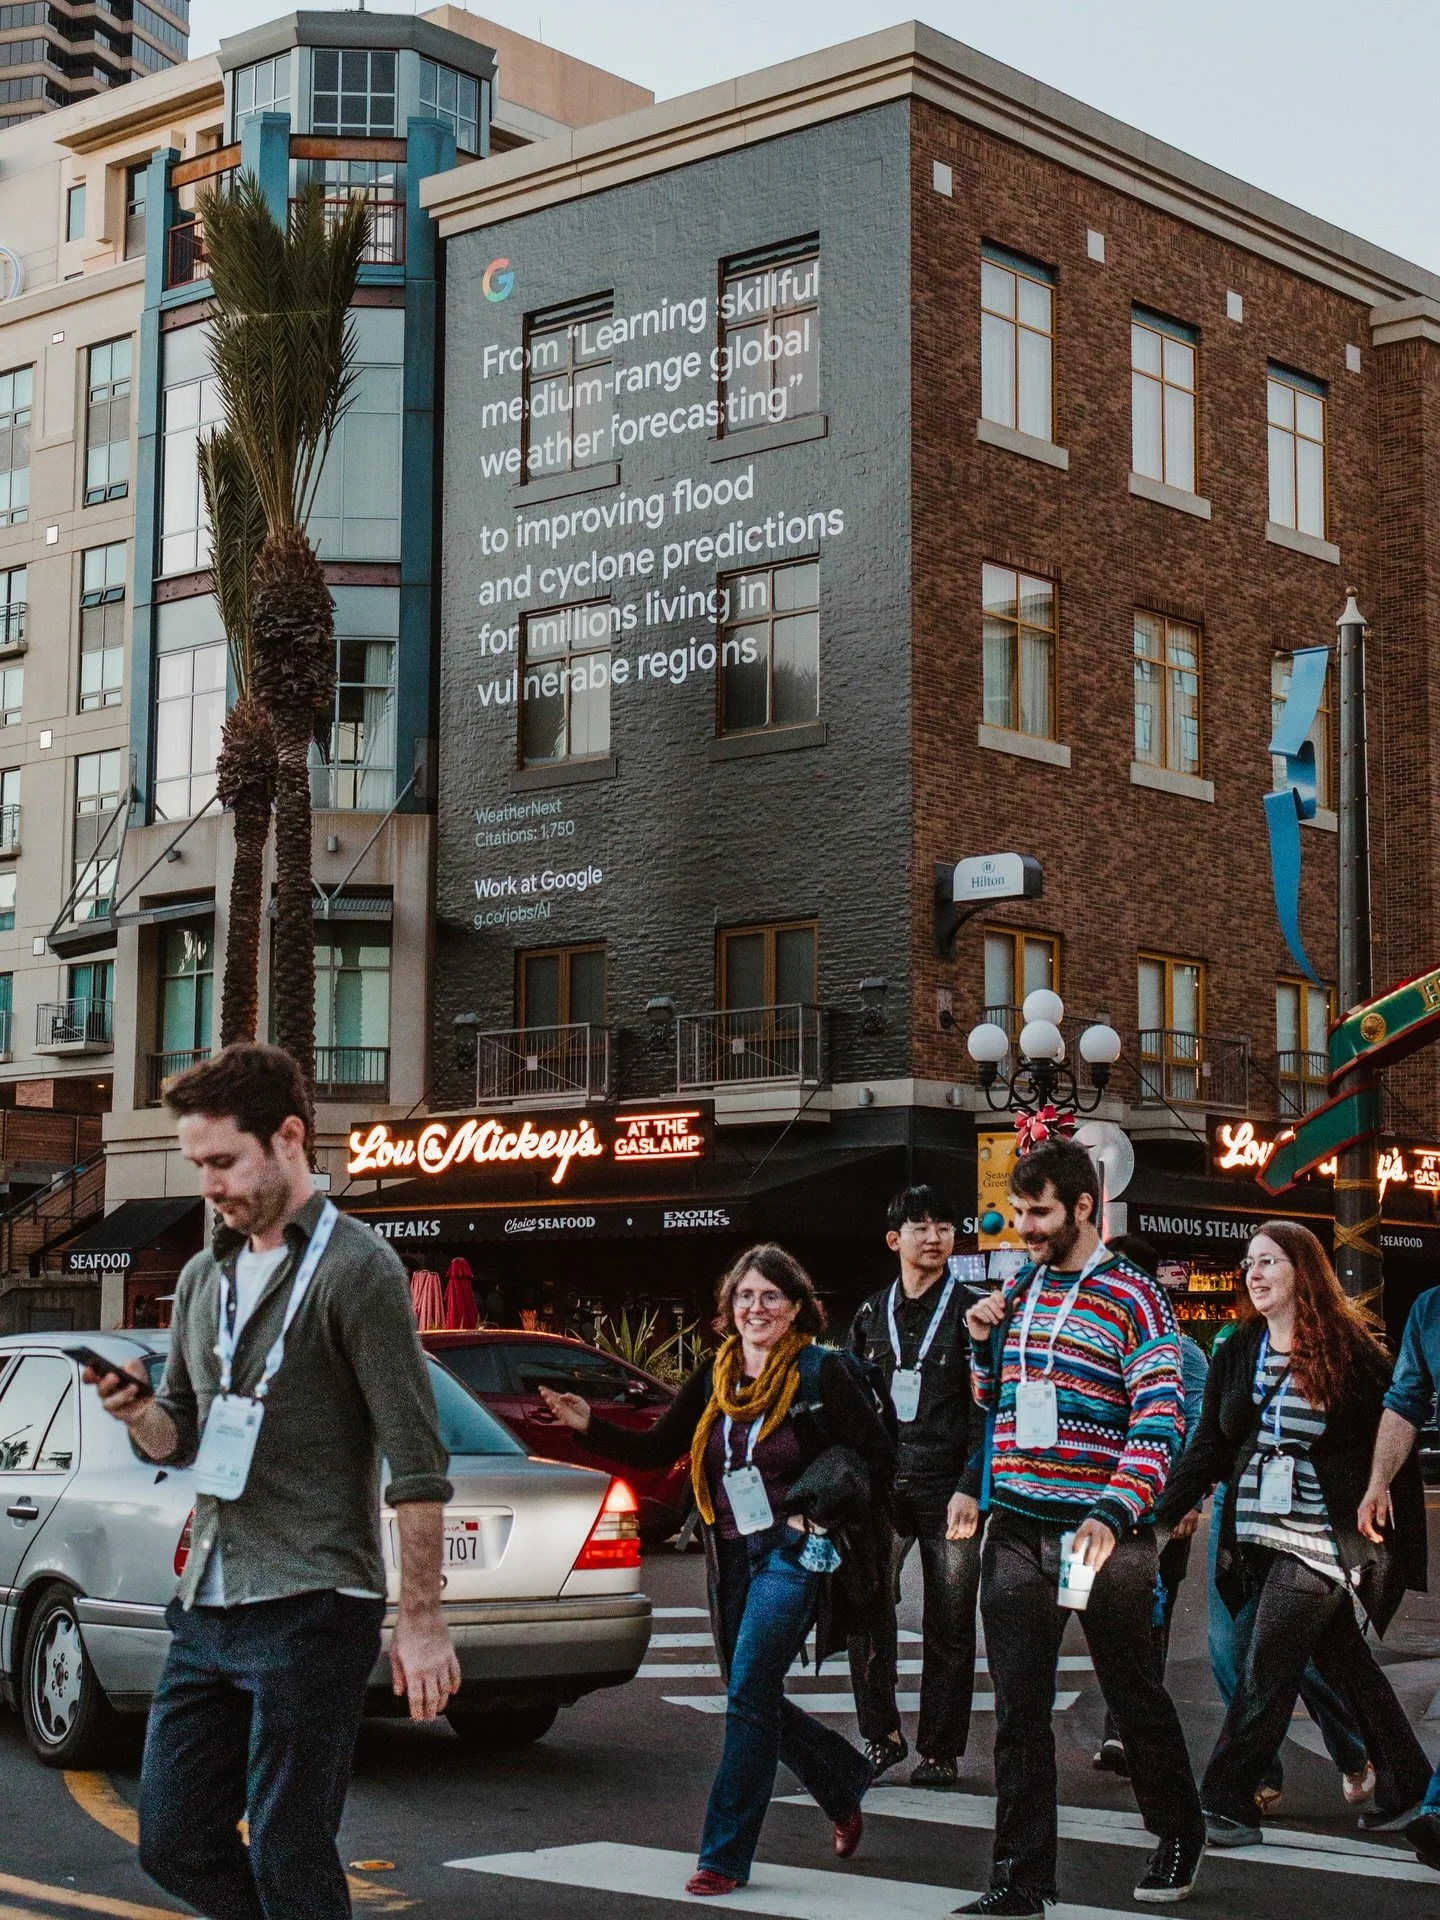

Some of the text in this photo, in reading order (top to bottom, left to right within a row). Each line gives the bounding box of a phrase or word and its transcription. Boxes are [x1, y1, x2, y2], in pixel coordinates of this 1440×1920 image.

[482, 338, 558, 379] From
[716, 262, 819, 319] skillful
[481, 318, 810, 429] medium-range global
[480, 425, 604, 478] weather
[479, 464, 754, 556] to improving flood
[478, 508, 845, 607] and cyclone predictions
[478, 576, 768, 657] for millions living in
[637, 635, 758, 686] regions
[475, 799, 562, 825] WeatherNext
[475, 820, 575, 848] Citations: 1,750
[475, 865, 603, 899] Work at Google
[971, 875, 1005, 889] Hilton
[474, 900, 551, 930] g.co/jobs/AI
[627, 1118, 689, 1137] AT THE
[347, 1124, 417, 1174] Lou
[449, 1118, 603, 1185] Mickey's
[614, 1135, 701, 1155] GASLAMP
[982, 1178, 1008, 1188] Greet
[504, 1216, 596, 1234] Choice SEAFOOD
[663, 1209, 726, 1220] EXOTIC
[663, 1217, 730, 1229] DRINKS
[1139, 1214, 1202, 1237] FAMOUS
[374, 1220, 441, 1238] STEAKS
[1384, 1235, 1423, 1248] SEAFOOD
[70, 1252, 131, 1270] SEAFOOD
